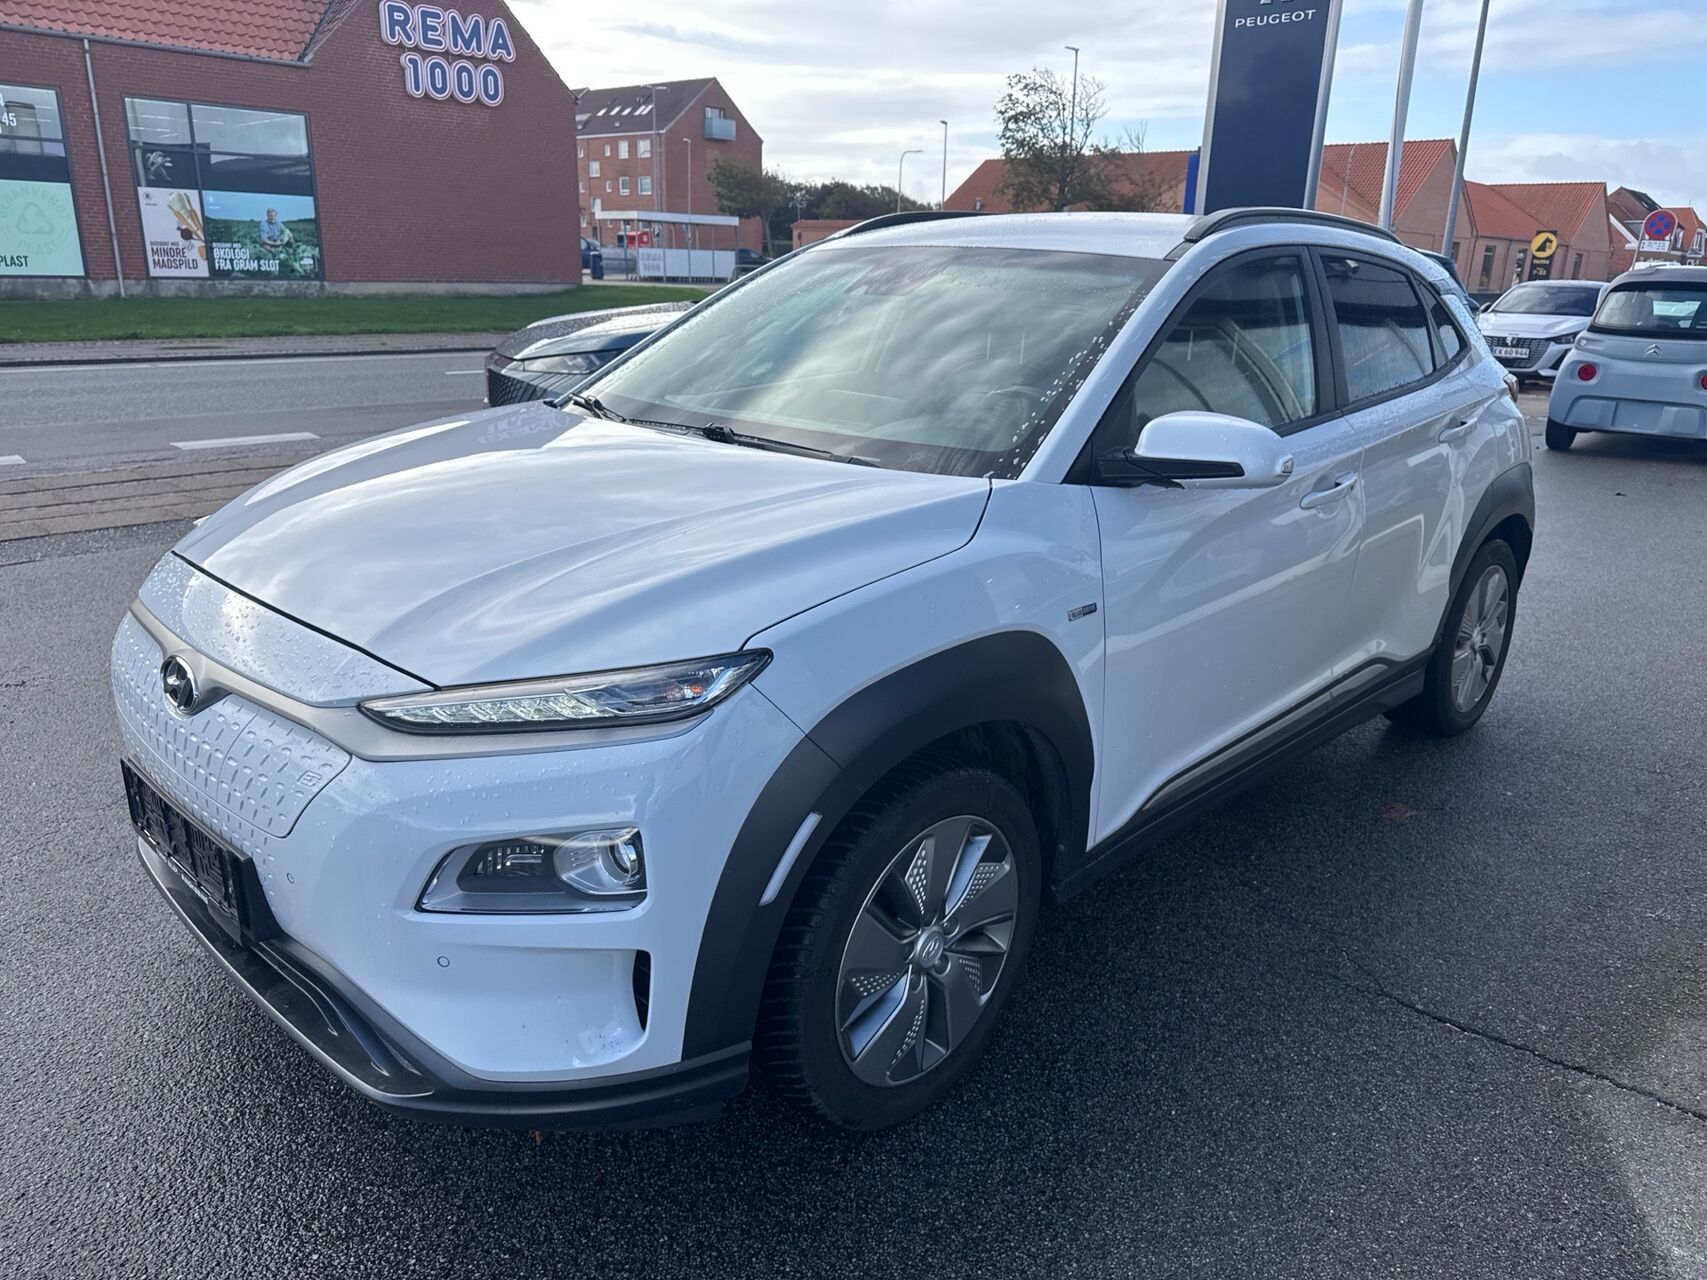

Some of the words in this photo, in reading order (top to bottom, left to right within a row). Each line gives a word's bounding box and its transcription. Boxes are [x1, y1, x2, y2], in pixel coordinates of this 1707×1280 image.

[1235, 9, 1316, 28] PEUGEOT
[379, 0, 516, 62] REMA
[401, 51, 504, 107] 1000
[151, 247, 187, 259] MINDRE
[213, 248, 250, 260] ØKOLOGI
[153, 258, 199, 270] MADSPILD
[215, 259, 232, 271] FRA
[233, 260, 258, 271] GRAM
[259, 260, 279, 271] SLOT
